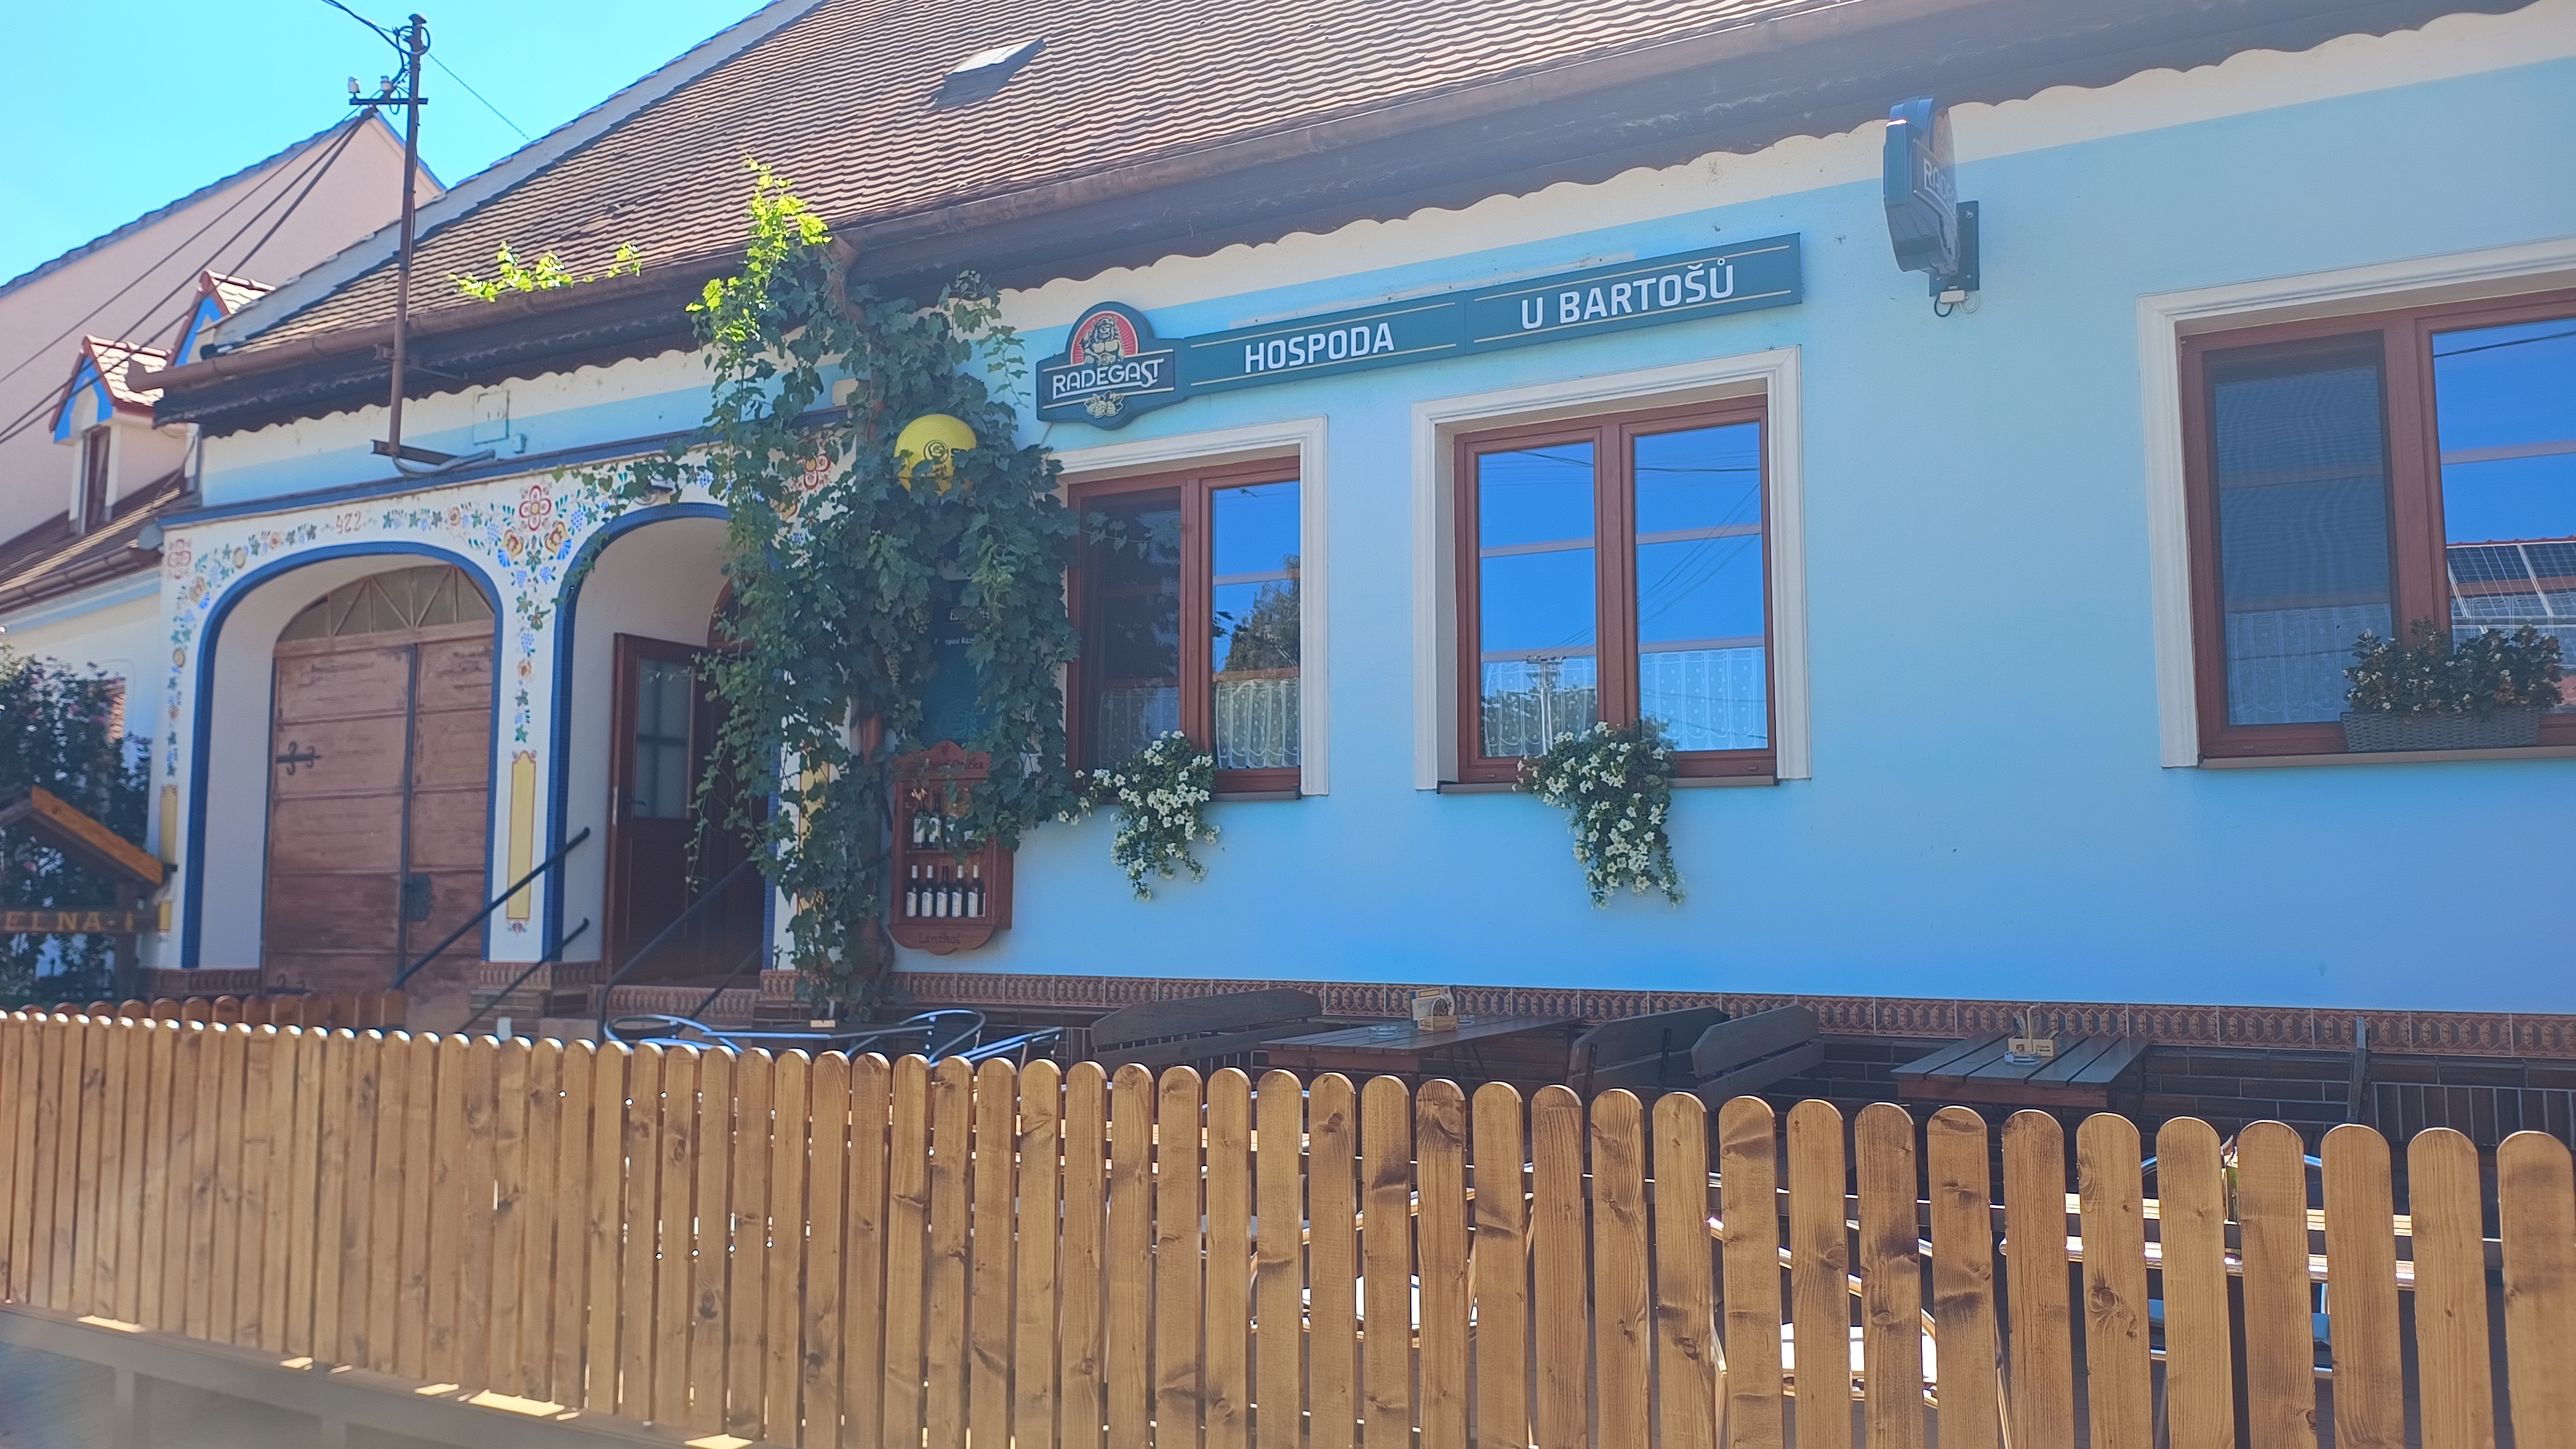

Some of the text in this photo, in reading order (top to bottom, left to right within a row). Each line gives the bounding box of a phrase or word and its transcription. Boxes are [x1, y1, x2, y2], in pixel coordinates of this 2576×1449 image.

[1245, 257, 1733, 373] HOSPODA U BARTOŠŮ
[1053, 358, 1164, 400] RADEGAST
